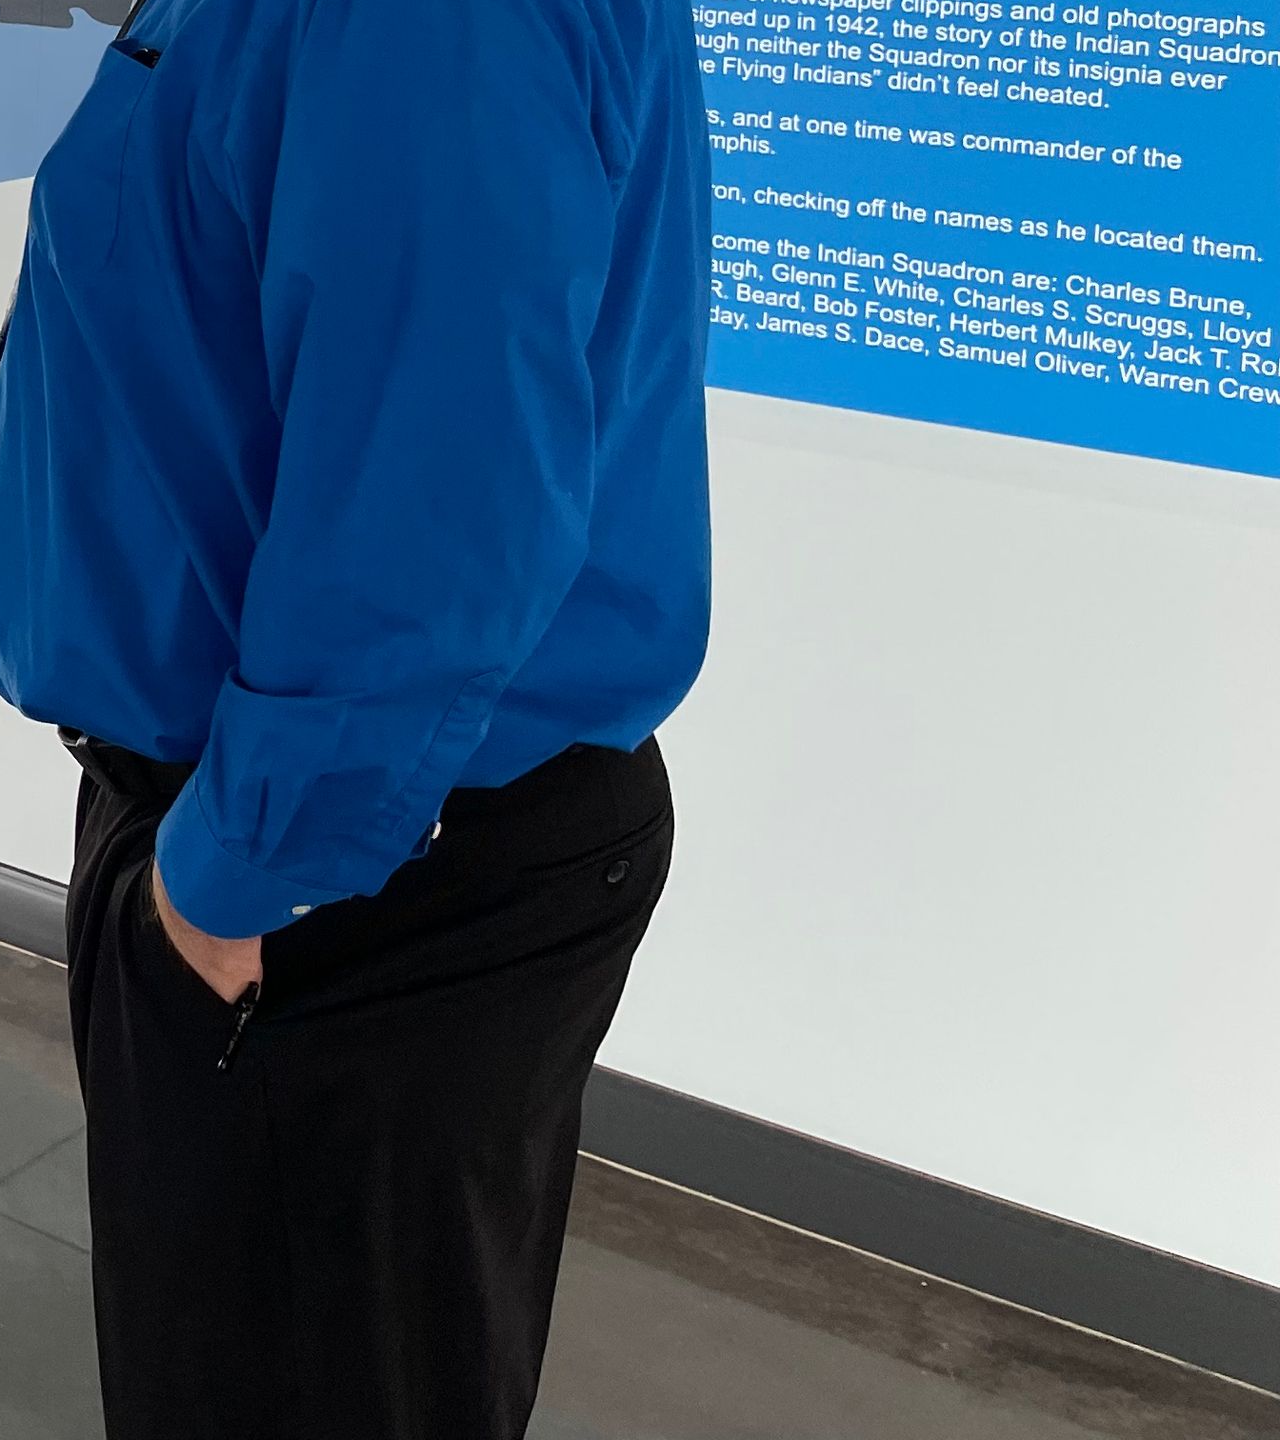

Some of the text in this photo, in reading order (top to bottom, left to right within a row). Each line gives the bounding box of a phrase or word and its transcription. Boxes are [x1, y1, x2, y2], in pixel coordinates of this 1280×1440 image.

[776, 238, 810, 260] the
[817, 243, 884, 269] Indian
[891, 252, 1004, 285] Squadron
[1010, 271, 1057, 292] are:
[1065, 274, 1160, 305] Charles
[1168, 286, 1251, 319] Brune,
